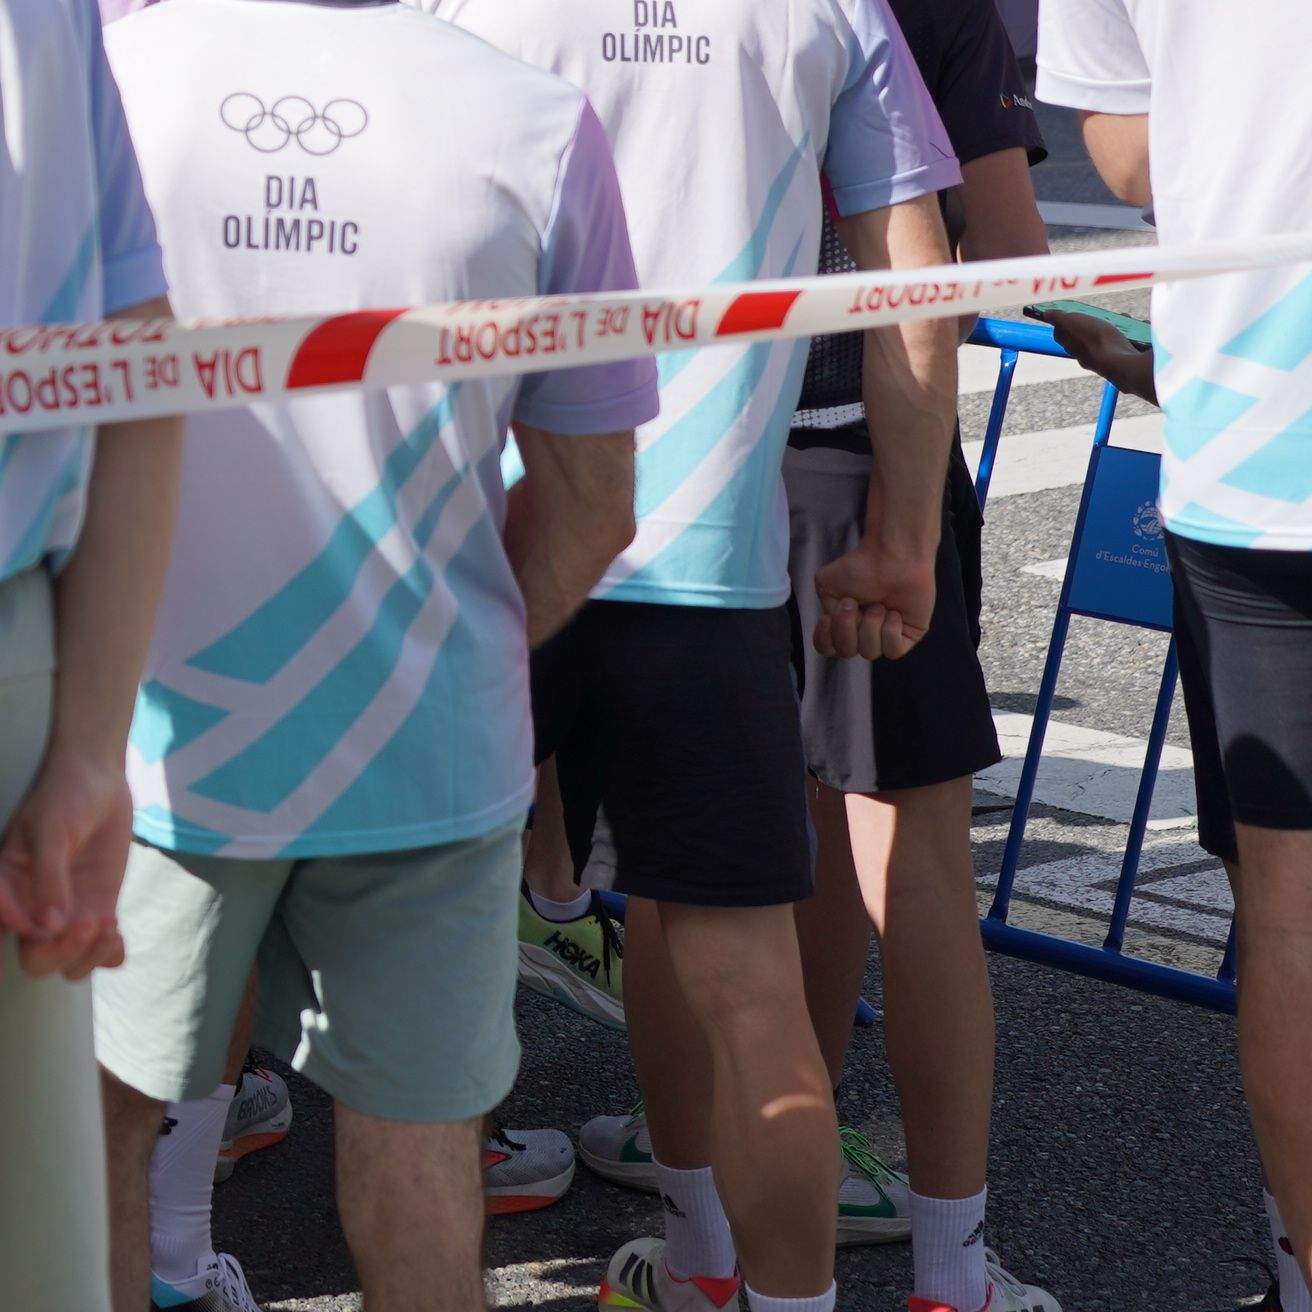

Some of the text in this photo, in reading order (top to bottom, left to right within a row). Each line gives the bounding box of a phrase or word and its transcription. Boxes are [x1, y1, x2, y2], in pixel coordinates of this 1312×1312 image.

[601, 28, 711, 66] OLÍMPIC
[265, 175, 319, 211] DIA
[223, 209, 359, 255] OLÍMPIC
[435, 307, 587, 366] L'ESPORT
[594, 304, 631, 337] DE
[640, 298, 703, 346] DIA
[142, 353, 180, 390] DE
[191, 344, 264, 400] DIA
[544, 930, 601, 979] HOKA
